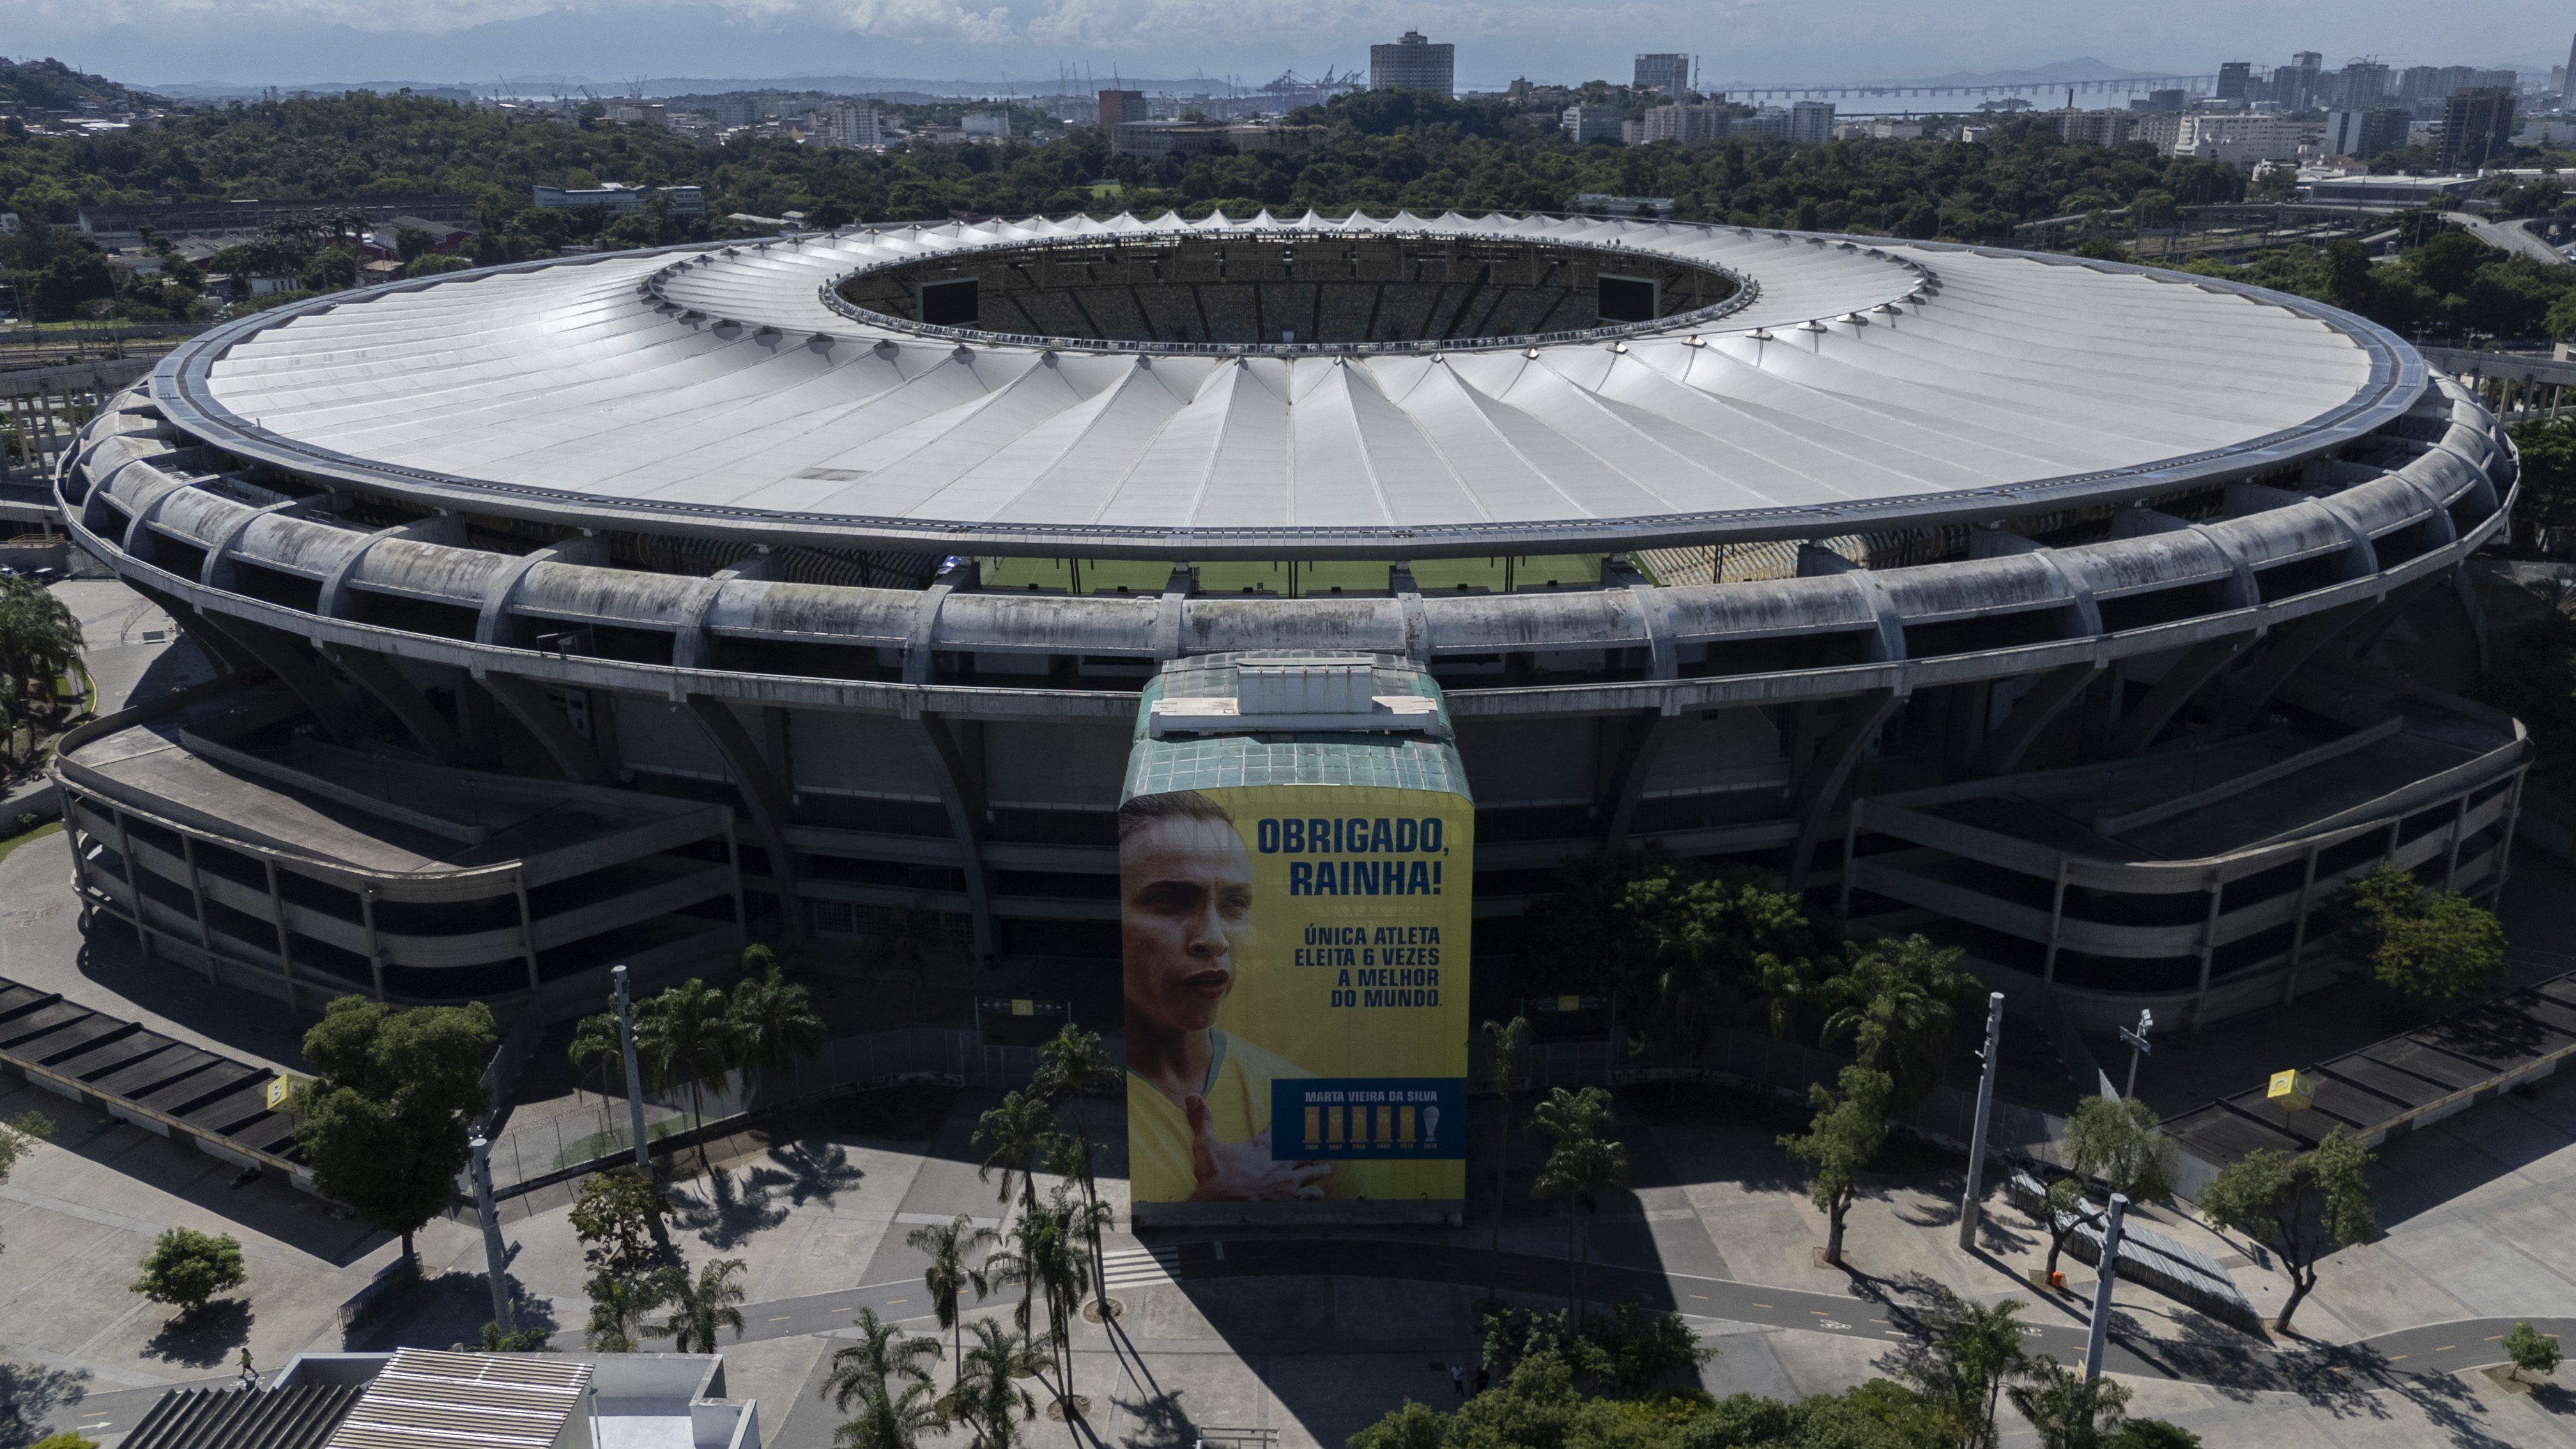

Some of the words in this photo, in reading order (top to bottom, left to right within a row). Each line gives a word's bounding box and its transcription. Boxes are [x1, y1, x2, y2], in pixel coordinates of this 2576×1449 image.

[1257, 817, 1449, 857] OBRIGADO,
[1290, 861, 1442, 896] RAINHA!
[1305, 923, 1367, 946] ÚNICA
[1374, 926, 1441, 945] ATLETA
[1294, 948, 1356, 967] ELEITA
[1363, 948, 1374, 966] 6
[1382, 947, 1440, 966] VEZES
[1338, 969, 1351, 987] A
[1358, 968, 1439, 986] MELHOR
[1331, 989, 1356, 1008] DO
[1364, 989, 1443, 1008] MUNDO.
[271, 1082, 282, 1103] B
[1305, 1091, 1344, 1102] MARTA
[1348, 1091, 1385, 1102] VIEIRA
[1388, 1091, 1404, 1101] DA
[1407, 1090, 1438, 1101] SILVA
